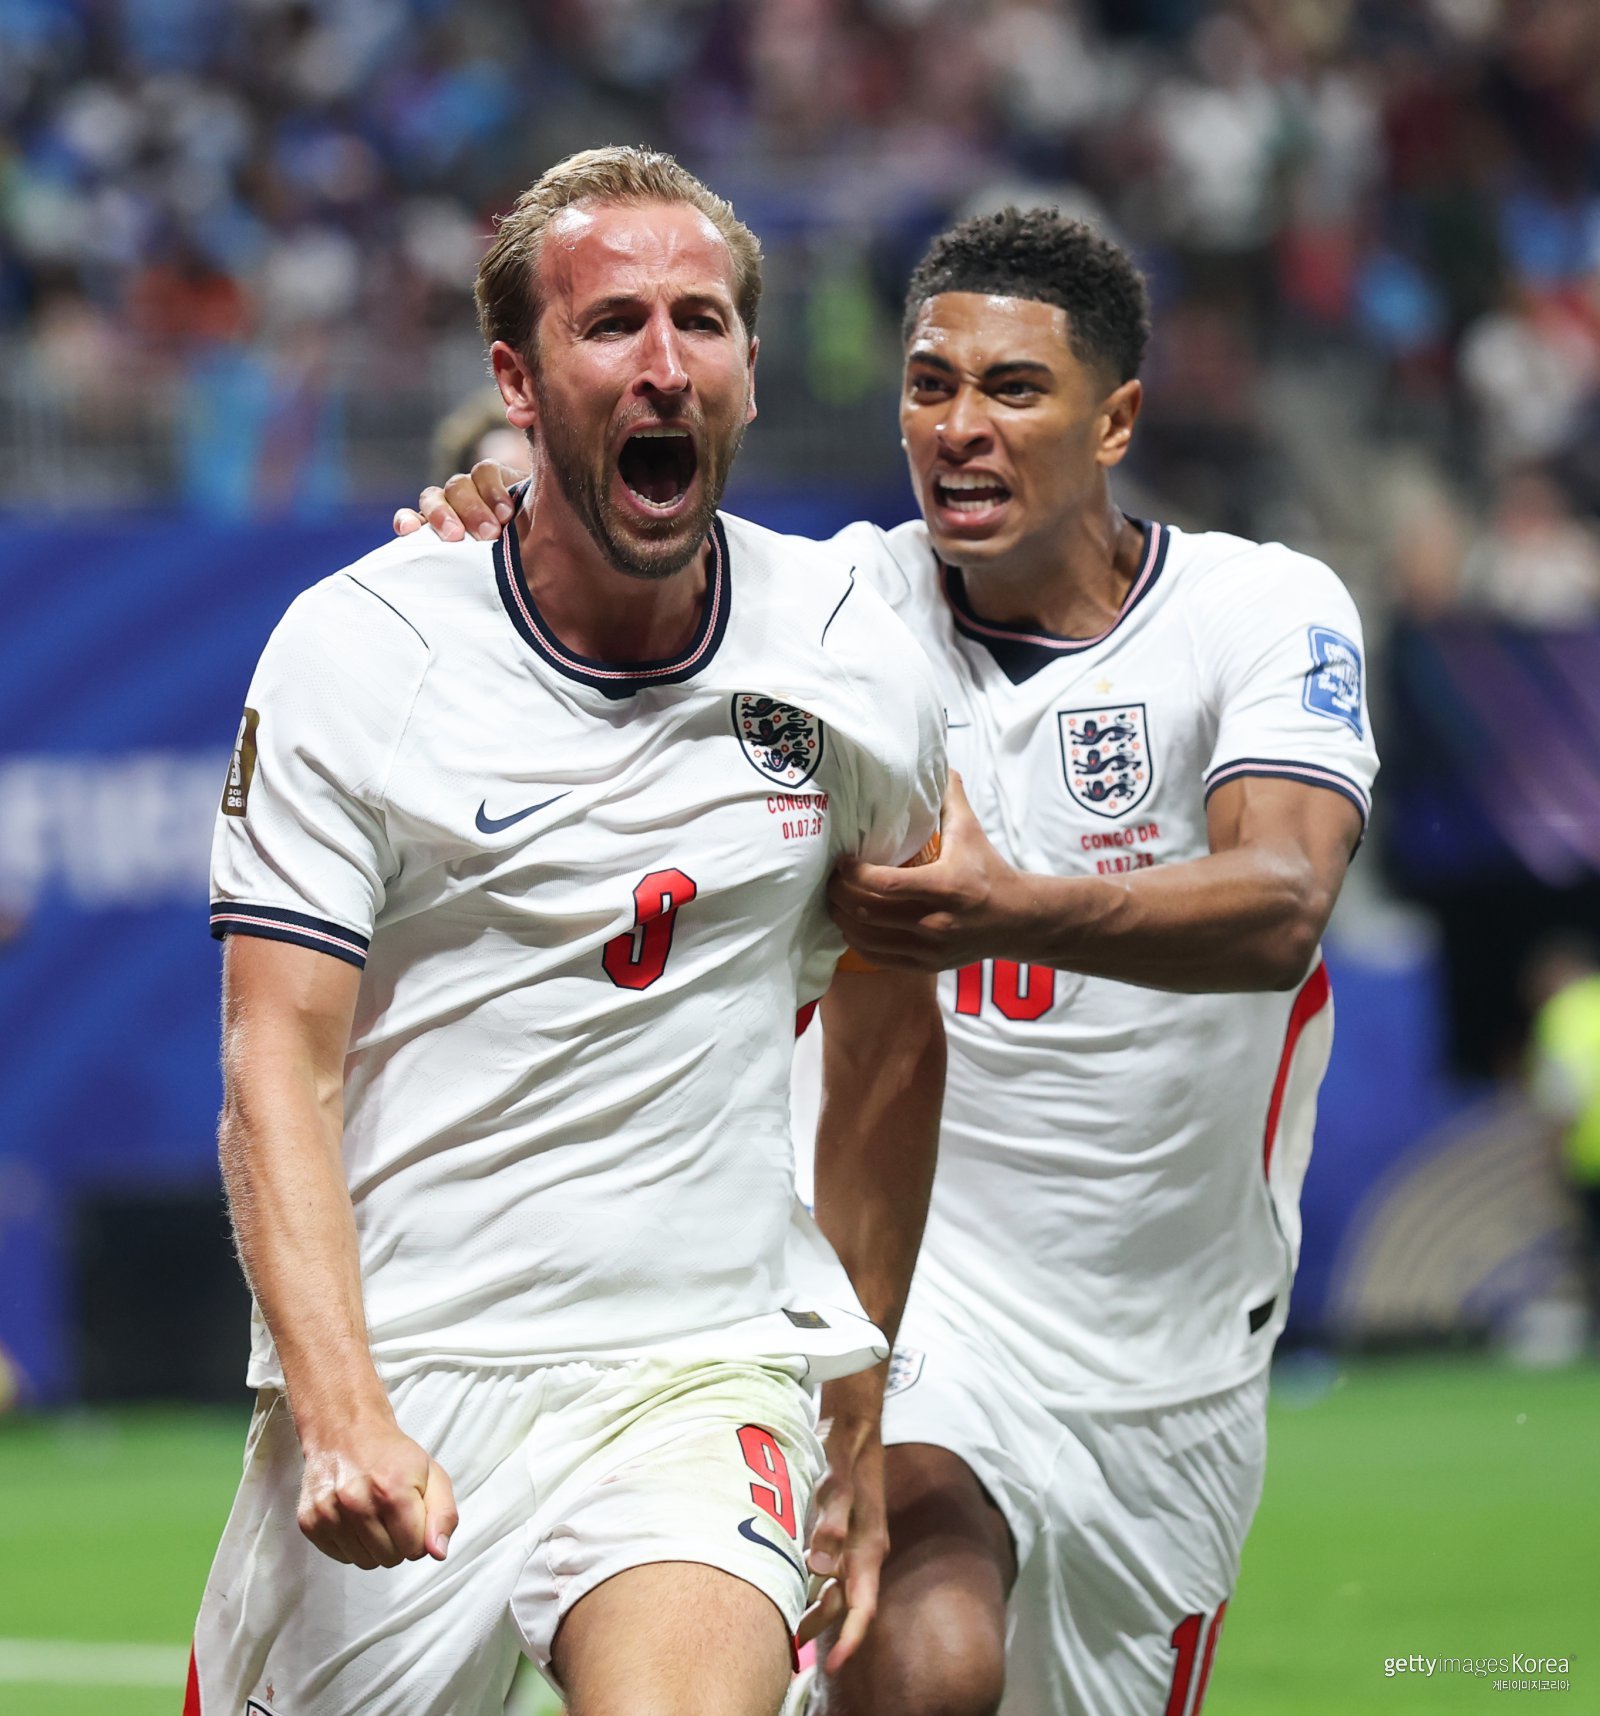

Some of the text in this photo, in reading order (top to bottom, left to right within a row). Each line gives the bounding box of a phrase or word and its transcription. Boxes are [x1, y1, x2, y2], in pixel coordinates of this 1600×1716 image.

[767, 794, 811, 814] CONGO
[782, 817, 822, 840] 01.07.26
[1081, 823, 1159, 851] CONGO DR
[736, 1423, 797, 1540] 9
